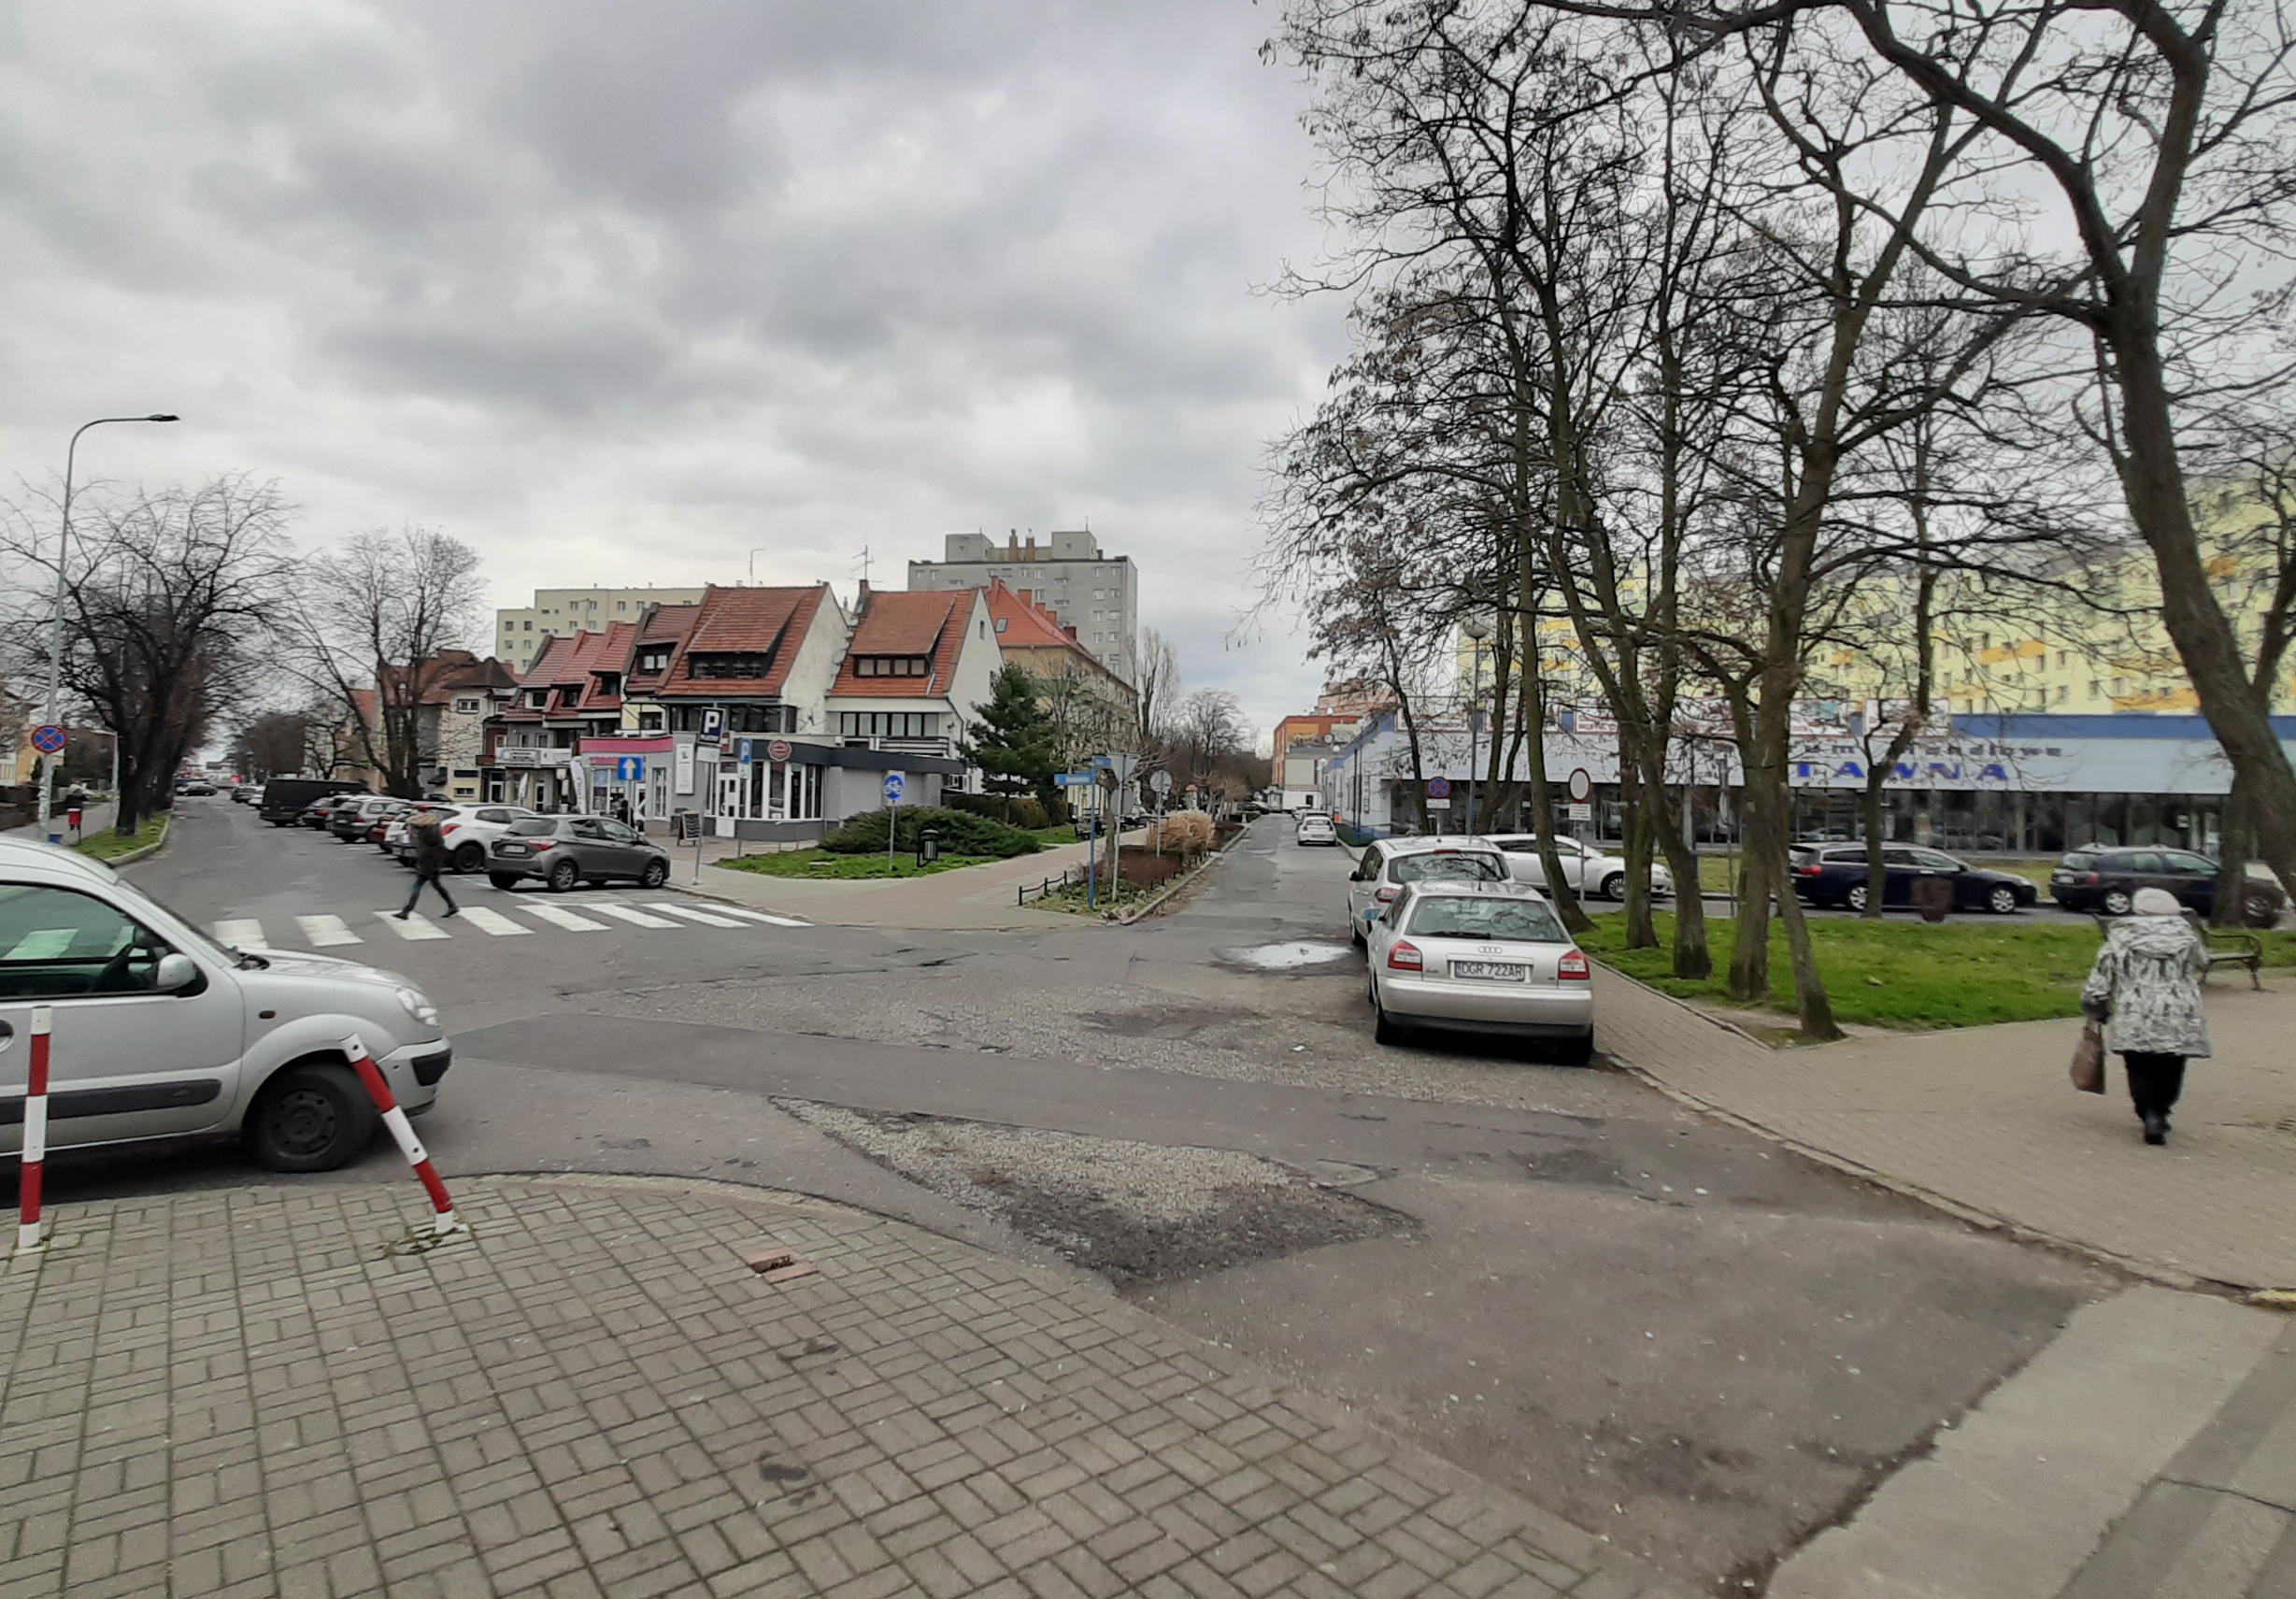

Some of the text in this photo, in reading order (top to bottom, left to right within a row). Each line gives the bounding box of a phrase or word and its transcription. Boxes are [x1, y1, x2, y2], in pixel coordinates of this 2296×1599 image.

[704, 710, 720, 733] P
[1462, 963, 1523, 978] DGR 722AR
